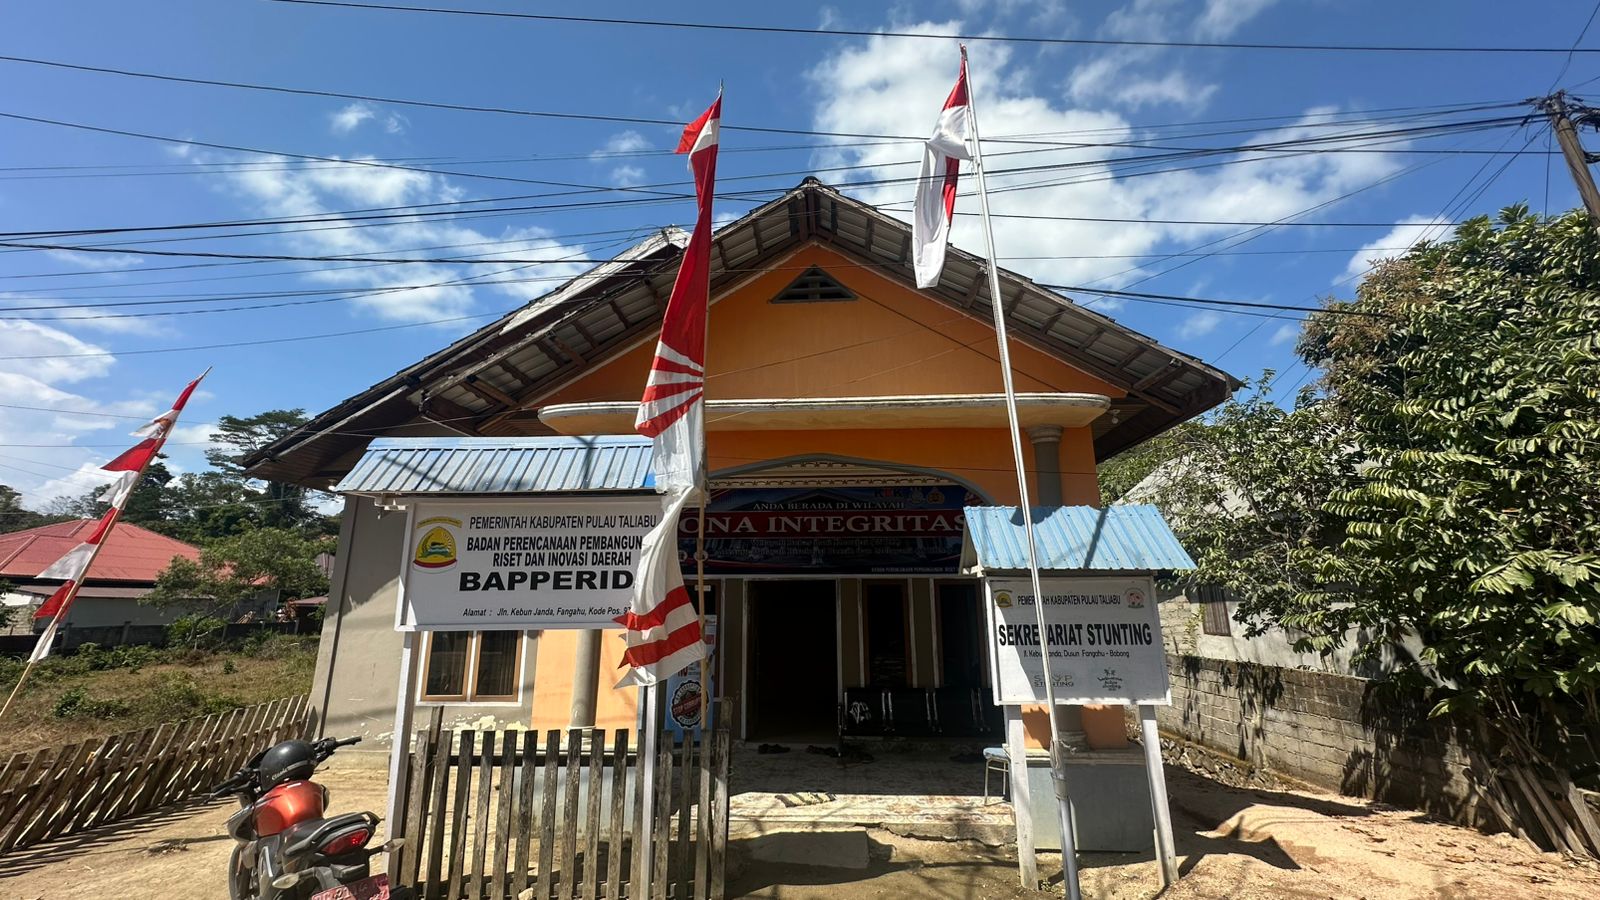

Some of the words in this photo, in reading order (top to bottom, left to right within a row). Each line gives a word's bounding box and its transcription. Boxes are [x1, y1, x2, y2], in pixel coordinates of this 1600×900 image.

[753, 502, 784, 510] ANDA
[787, 502, 833, 510] BERADA
[836, 502, 848, 510] DI
[851, 501, 905, 509] WILAYAH
[469, 516, 528, 529] PEMERINTAH
[529, 515, 584, 529] KABUPATEN
[586, 515, 616, 528] PULAU
[619, 515, 657, 528] TALIABU
[679, 516, 758, 533] ONA
[766, 514, 964, 533] INTEGRITAS
[467, 536, 501, 551] BADAN
[503, 536, 577, 551] PERENCANAAN
[580, 535, 643, 550] PEMBANGUN
[493, 552, 522, 567] RISET
[525, 552, 545, 567] DAN
[548, 552, 588, 567] INOVASI
[592, 552, 631, 566] DAERAH
[459, 571, 635, 591] BAPPERID
[1051, 595, 1080, 605] KABUPATEN
[1081, 595, 1098, 605] PULAU
[1099, 595, 1120, 605] TALIABU
[463, 608, 486, 617] Alamat
[497, 608, 509, 616] Jln.
[510, 607, 532, 616] Kebun
[533, 607, 555, 618] Janda,
[556, 607, 587, 618] Fangahu,
[588, 606, 606, 616] Kode
[607, 606, 621, 616] Pos.
[999, 624, 1083, 646] SEKREARIAT
[1087, 623, 1153, 645] STUNTING
[1047, 650, 1062, 658] anda,
[1082, 650, 1105, 658] Fangahu
